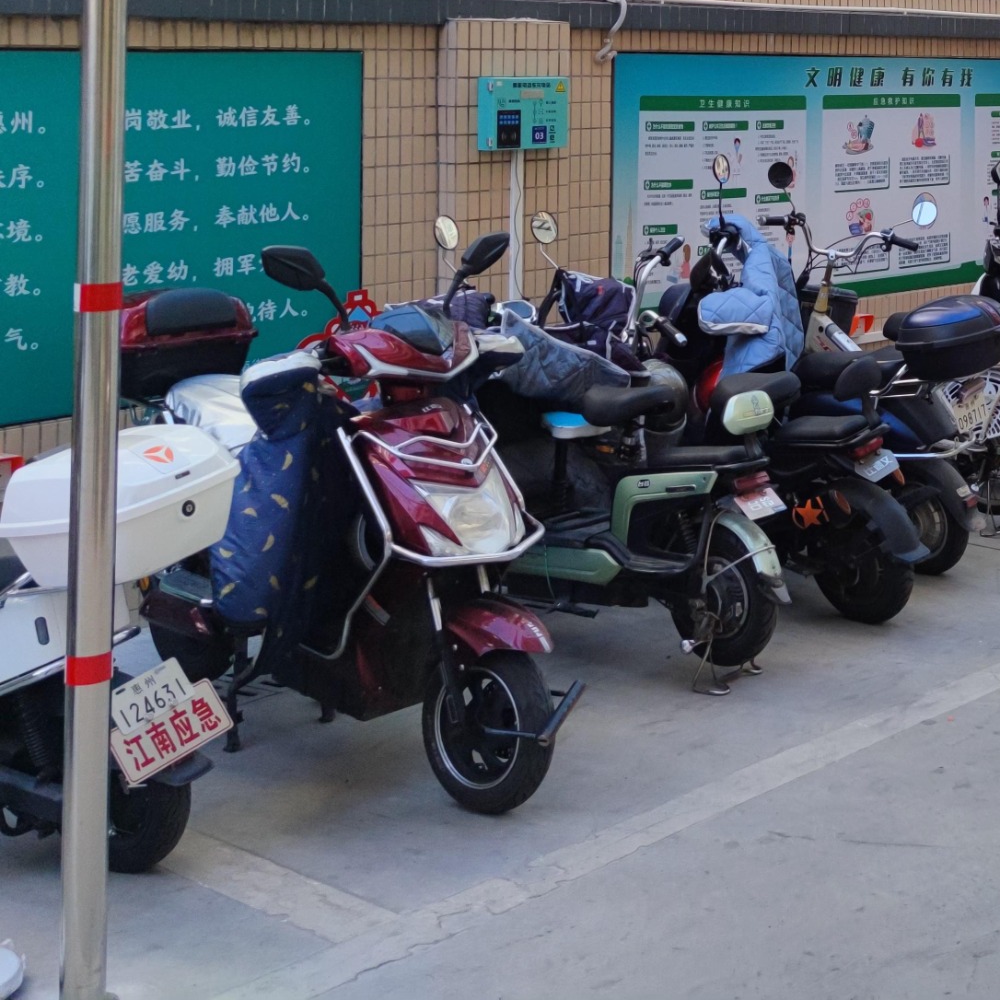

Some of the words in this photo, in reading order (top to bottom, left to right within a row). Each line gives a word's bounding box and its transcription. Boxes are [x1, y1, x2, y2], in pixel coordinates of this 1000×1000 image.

[805, 66, 886, 88] 文明健康
[901, 66, 974, 88] 有你有我
[699, 98, 750, 109] 卫生健康知识
[534, 132, 544, 140] 03
[0, 218, 43, 243] 境。
[0, 273, 41, 298] 教。
[4, 327, 39, 351] 气。
[131, 674, 157, 695] 惠州
[120, 678, 187, 728] 124631
[123, 697, 222, 772] 江南应急
